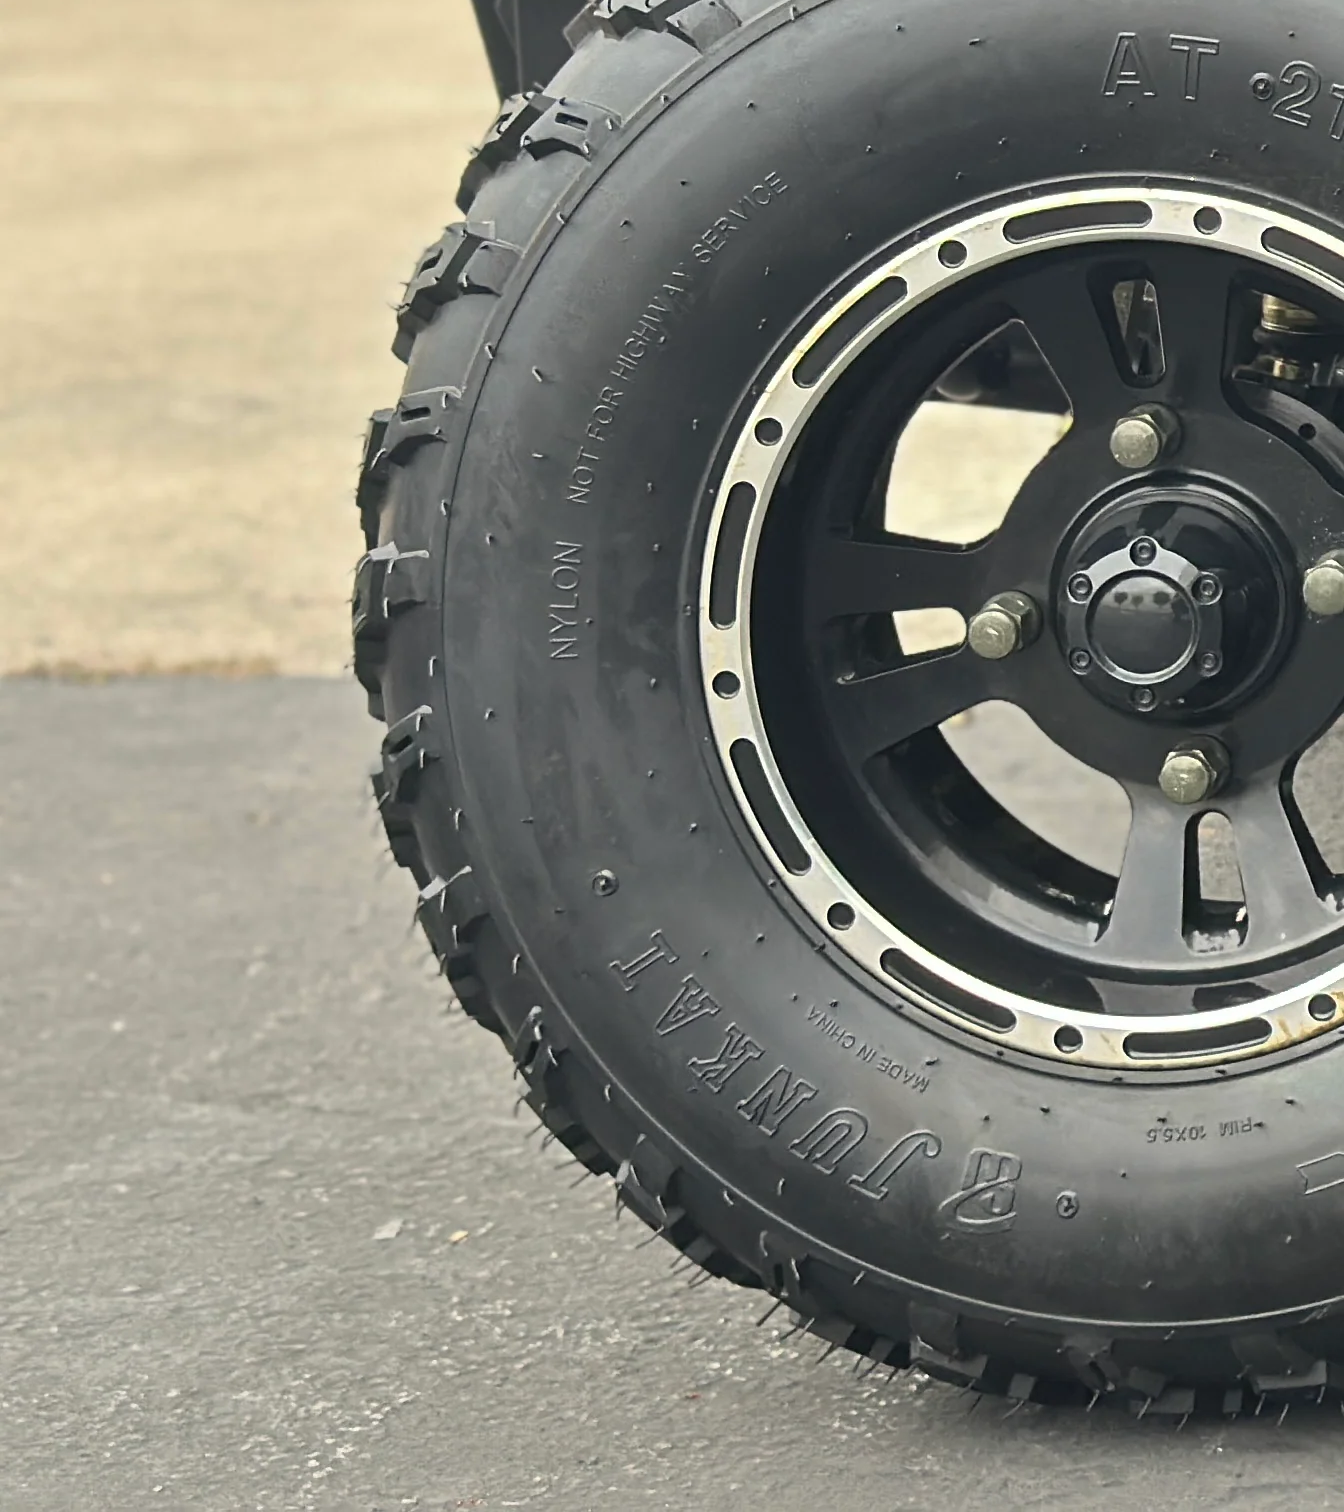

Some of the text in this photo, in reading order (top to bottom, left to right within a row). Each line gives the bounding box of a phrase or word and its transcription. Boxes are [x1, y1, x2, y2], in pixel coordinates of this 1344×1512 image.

[1101, 31, 1220, 101] AT
[690, 169, 789, 264] SERVICE
[586, 385, 624, 443] FOR
[566, 445, 601, 505] NOT
[548, 539, 585, 660] NYLON
[608, 928, 943, 1201] JUNKAI
[805, 1004, 931, 1095] MADE IN CHINA
